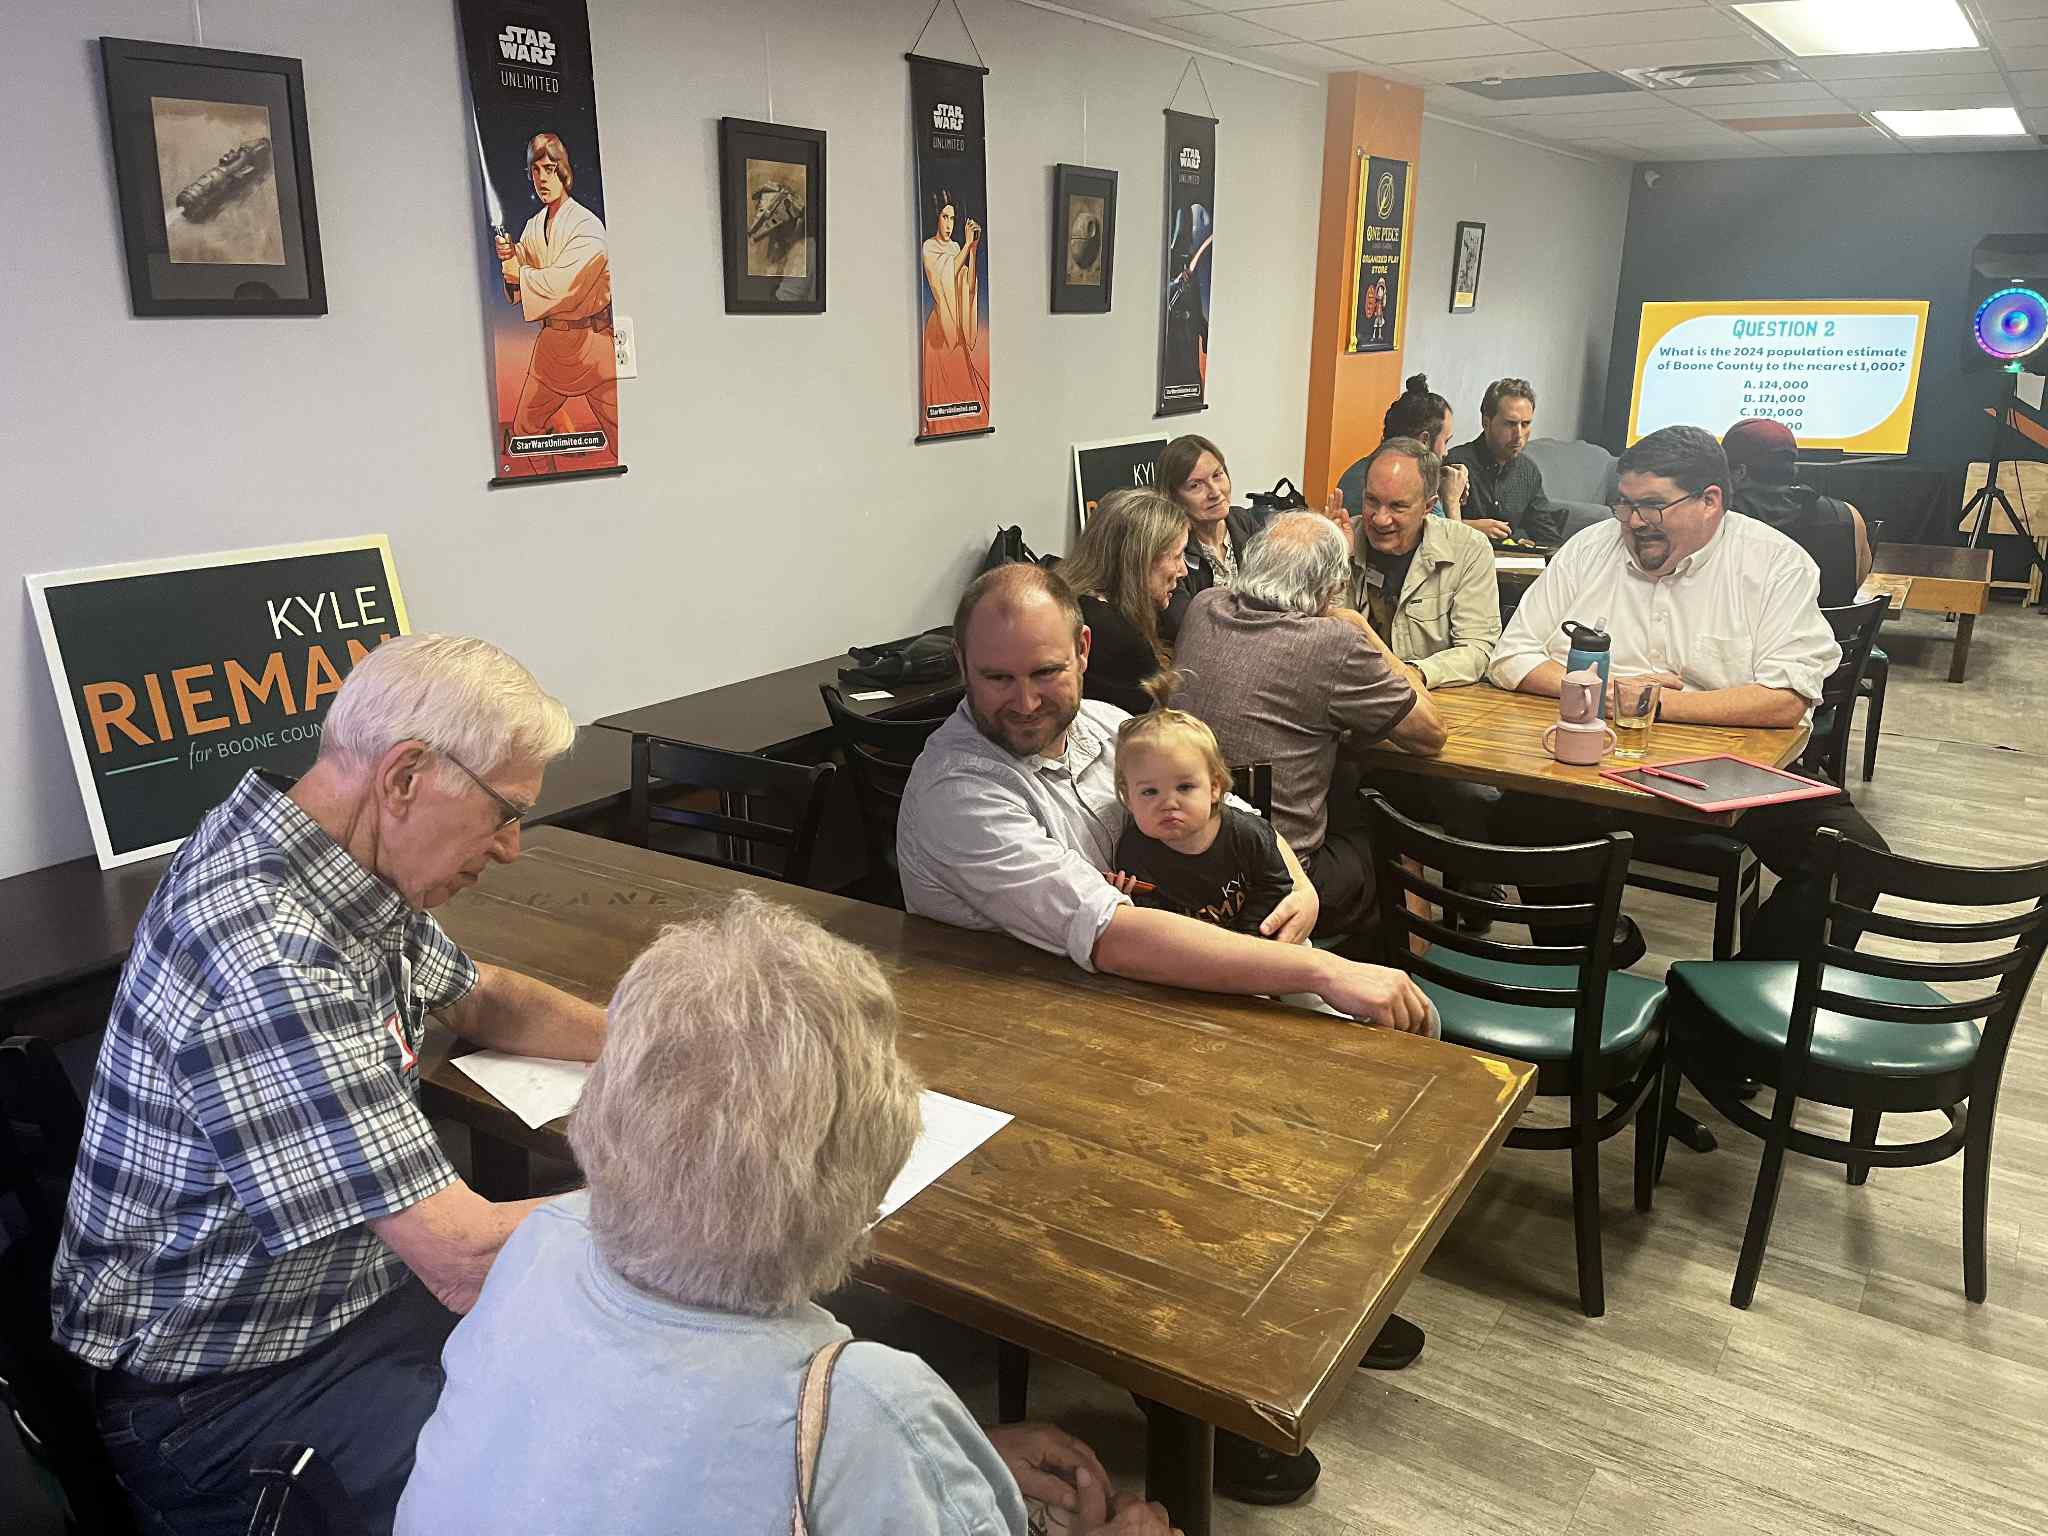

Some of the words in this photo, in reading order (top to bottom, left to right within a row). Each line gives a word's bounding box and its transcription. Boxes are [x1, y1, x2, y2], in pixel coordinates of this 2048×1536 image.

[499, 25, 556, 50] STAR
[499, 41, 556, 66] WARS
[501, 71, 559, 93] UNLIMITED
[933, 104, 964, 119] STAR
[933, 116, 964, 131] WARS
[1824, 321, 1835, 337] 2
[1660, 347, 1694, 357] What
[1697, 346, 1707, 356] is
[1710, 347, 1731, 356] the
[1734, 347, 1763, 356] 2024
[1767, 346, 1843, 358] population
[1847, 346, 1907, 357] estimate
[1657, 361, 1671, 370] of
[1673, 361, 1713, 370] Boone
[1716, 361, 1763, 373] County
[1766, 362, 1781, 370] to
[1782, 362, 1804, 371] the
[1807, 362, 1857, 371] nearest
[1860, 362, 1905, 373] 1,000?
[1744, 380, 1756, 389] A.
[1757, 394, 1805, 404] 171,000
[1740, 407, 1750, 416] C.
[1753, 408, 1803, 418] 192,000
[516, 437, 599, 450] StarWarsUnlimited.com
[267, 585, 386, 640] KYLE
[189, 742, 213, 770] for
[217, 732, 279, 758] BOONE
[281, 722, 324, 743] COUN
